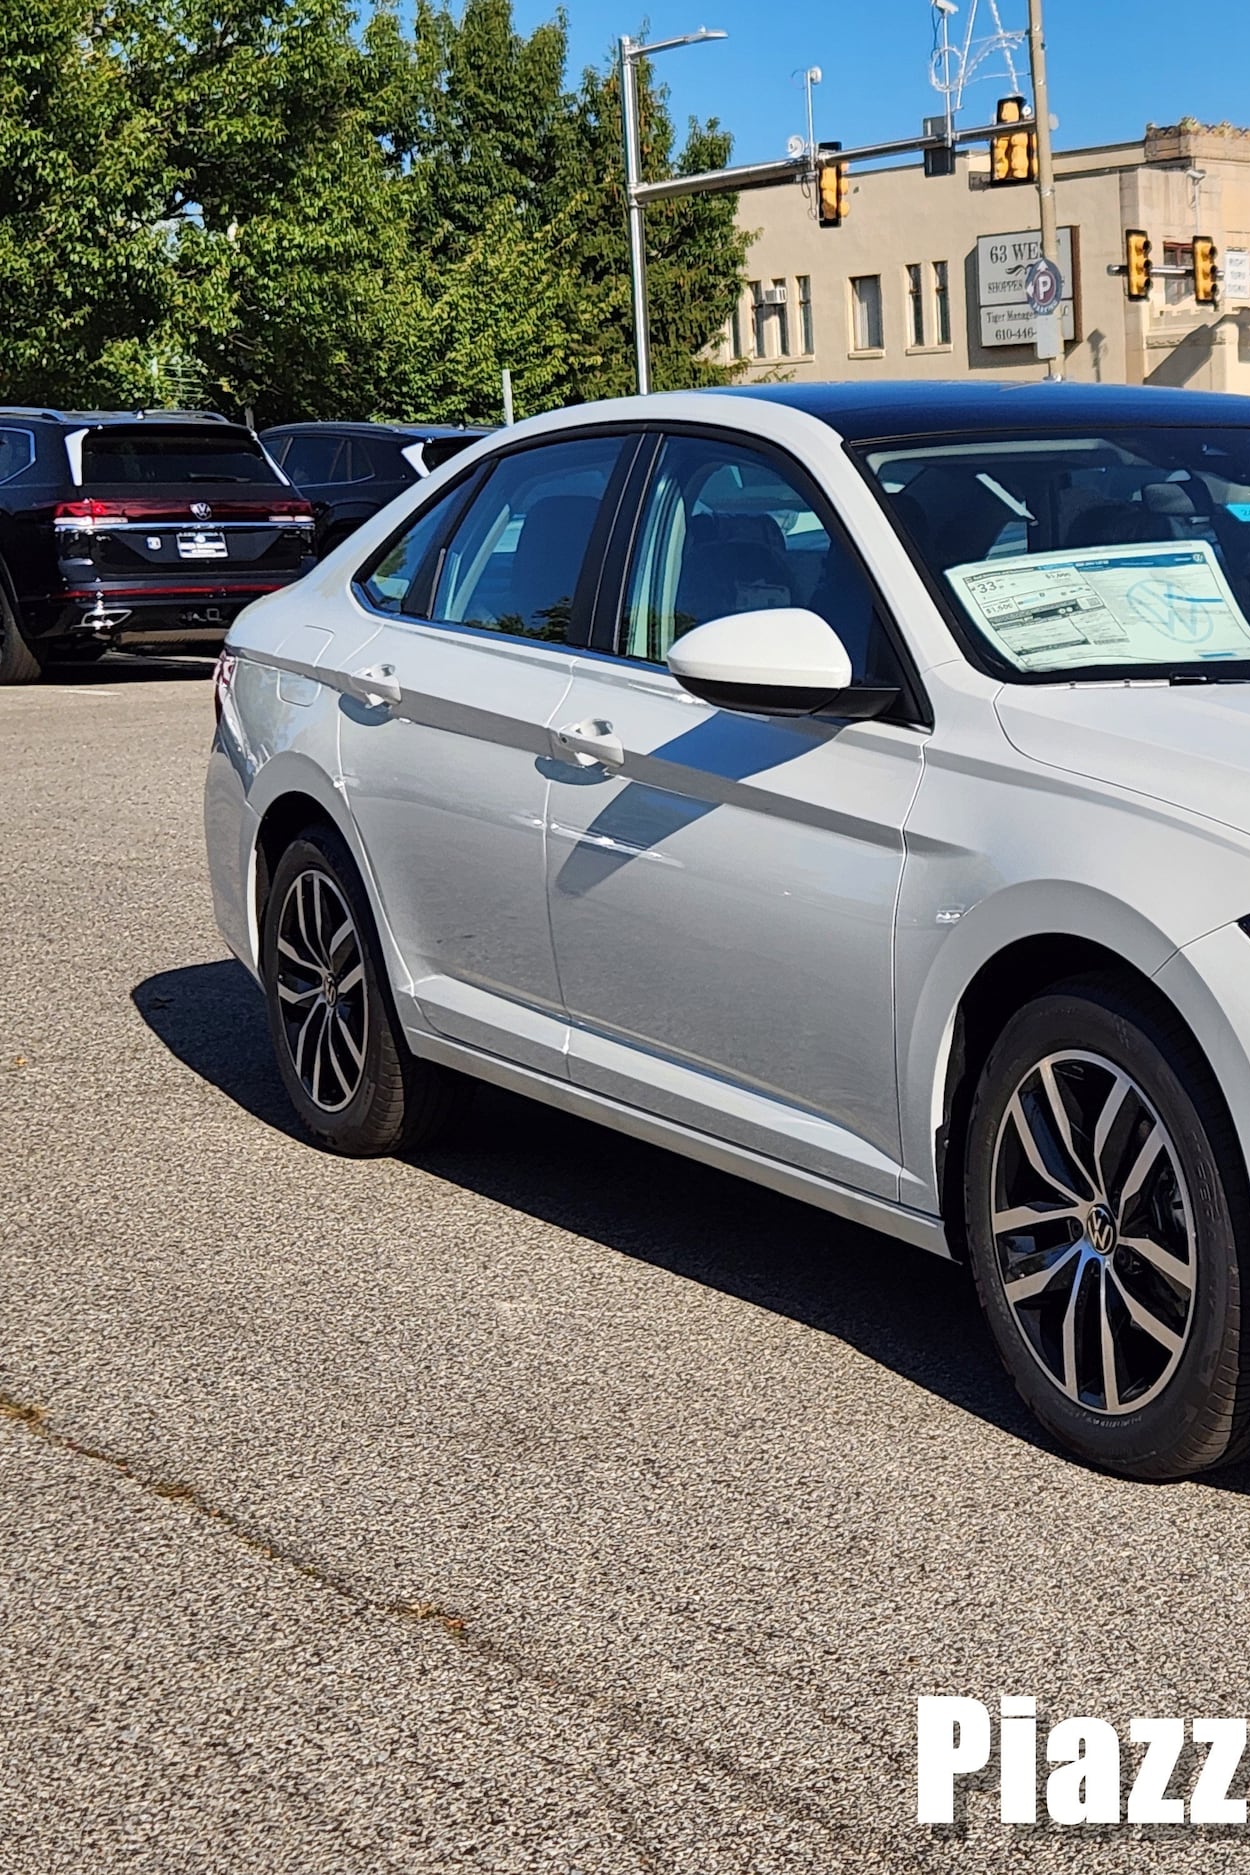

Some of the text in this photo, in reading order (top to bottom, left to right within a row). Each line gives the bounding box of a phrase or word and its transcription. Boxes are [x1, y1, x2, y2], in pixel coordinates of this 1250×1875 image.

[989, 245, 1007, 263] 63
[1037, 275, 1052, 300] P
[977, 581, 997, 594] 33
